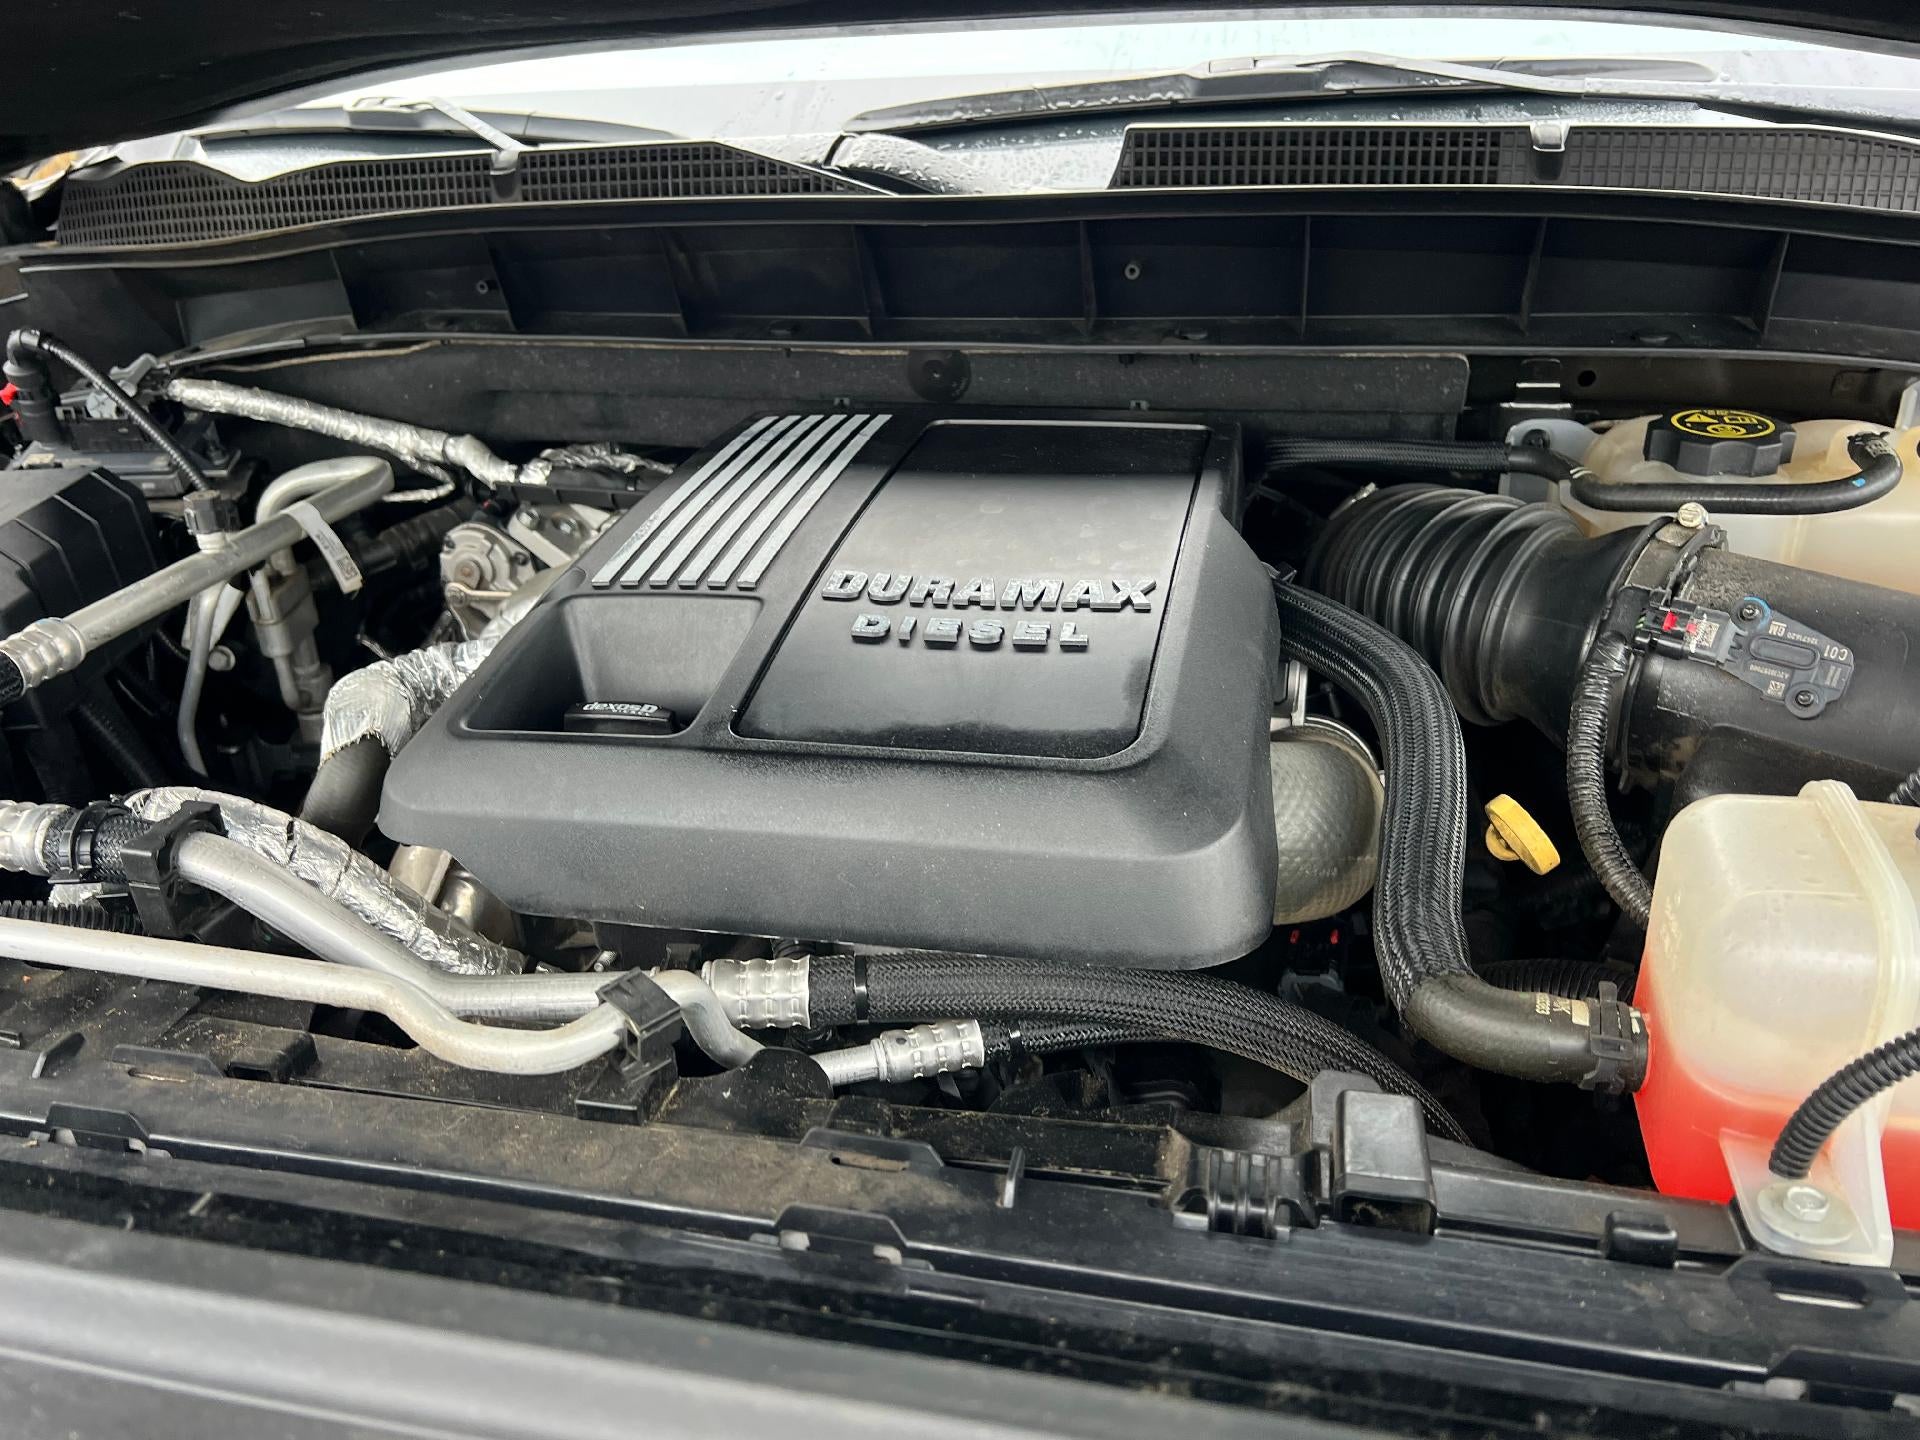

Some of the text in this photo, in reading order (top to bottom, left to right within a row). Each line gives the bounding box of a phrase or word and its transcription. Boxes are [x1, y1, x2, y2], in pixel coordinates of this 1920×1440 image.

[821, 570, 1156, 610] DURAMAX
[851, 614, 1088, 646] DIESEL
[1769, 621, 1786, 637] GM
